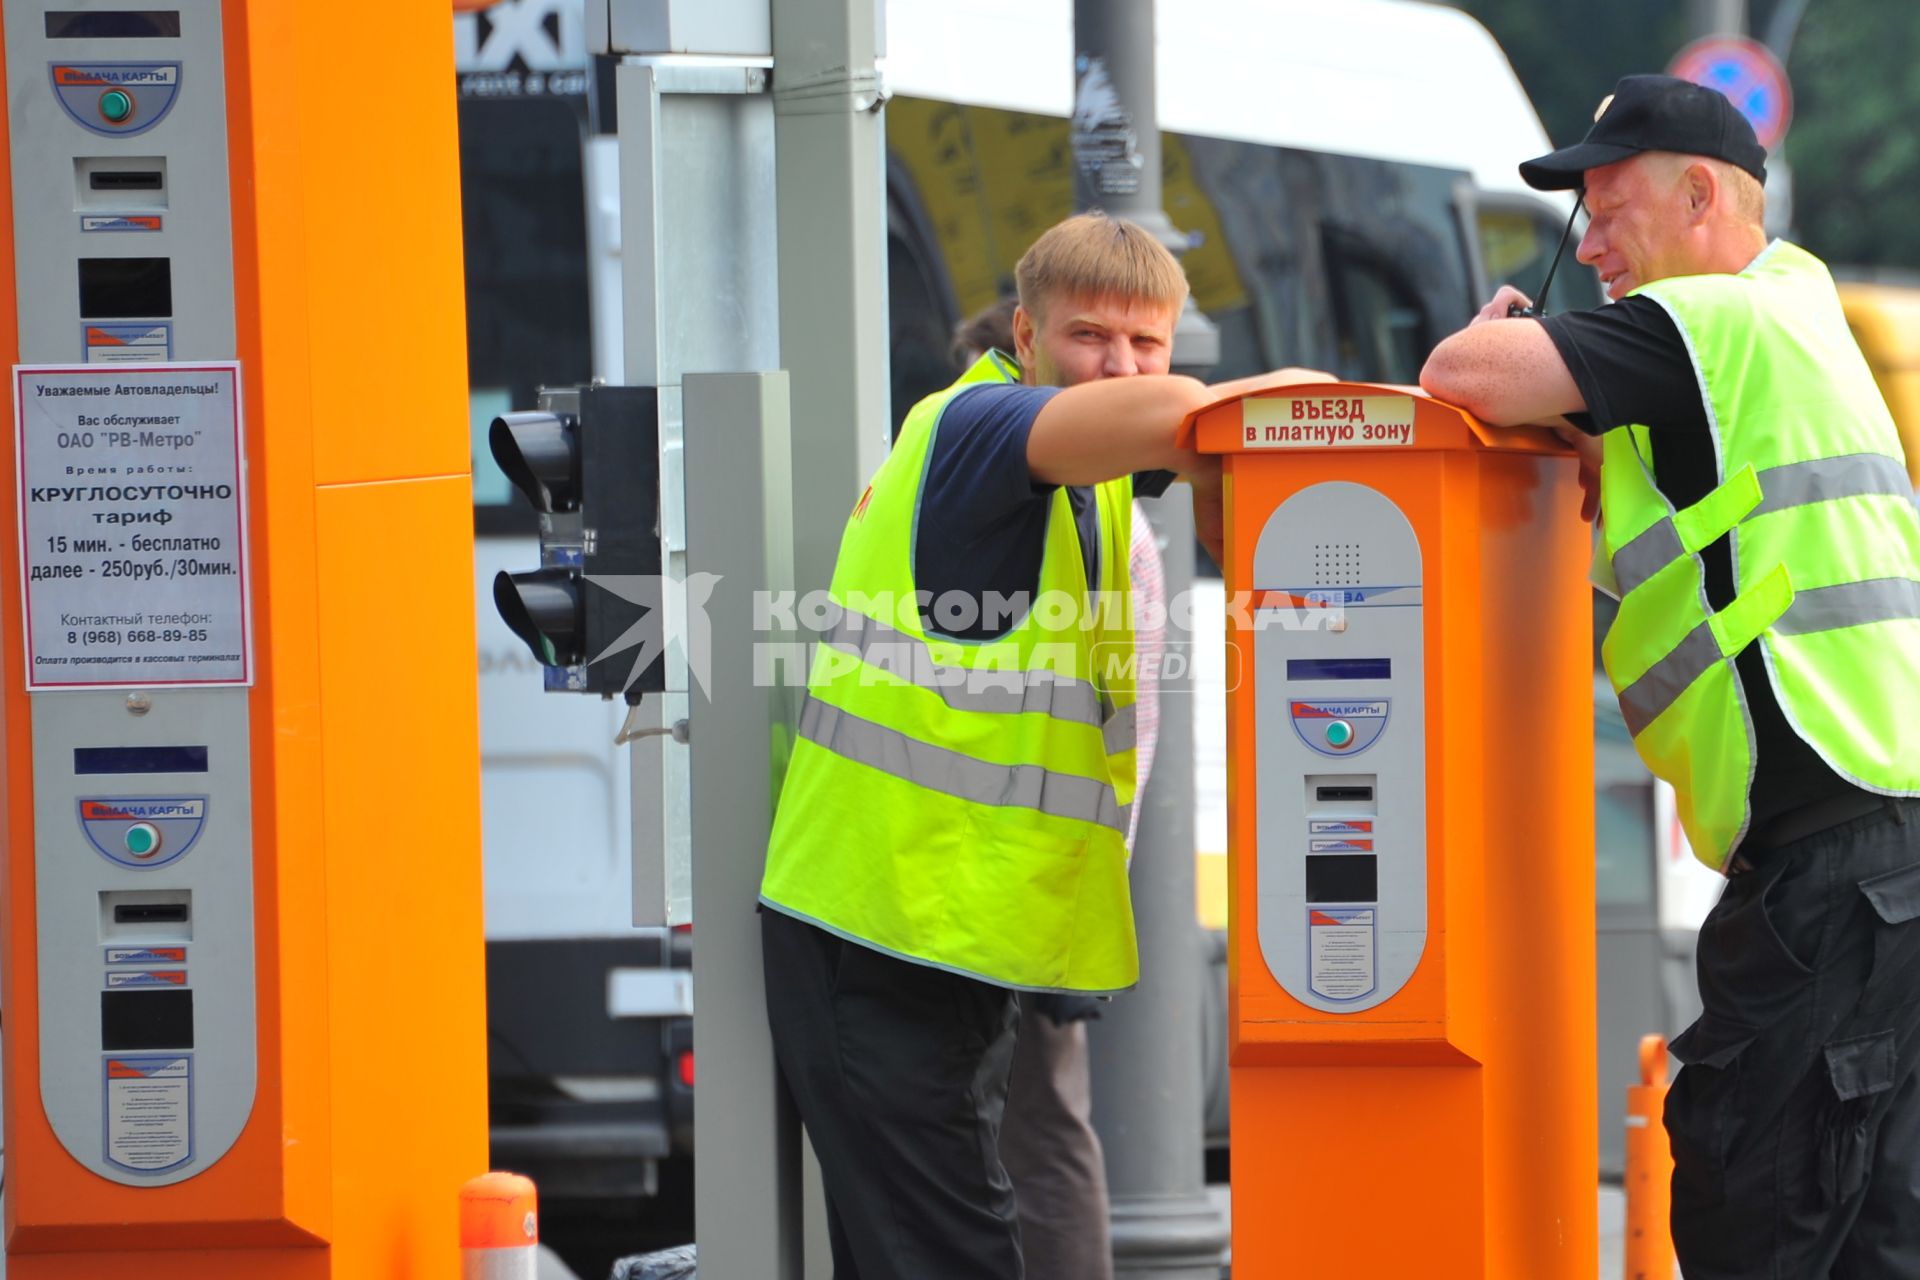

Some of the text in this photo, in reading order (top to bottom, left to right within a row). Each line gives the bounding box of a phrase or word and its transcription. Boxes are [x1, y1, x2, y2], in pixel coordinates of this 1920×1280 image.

[64, 71, 167, 81] ВЫДАЧА КАРТЫ
[36, 382, 219, 397] Уважаемые Автовладельцы!
[1291, 399, 1365, 423] ВЪЕЗД
[77, 414, 181, 428] Вас обслуживает
[57, 430, 202, 450] ОАО "РВ-Метро"
[1245, 424, 1411, 445] в платную зону
[65, 465, 193, 476] Время работы:
[30, 484, 232, 503] КРУГЛОСУТОЧНО
[92, 509, 173, 526] тариф
[47, 536, 67, 553] 15
[73, 539, 112, 553] мин.
[131, 534, 221, 551] бесплатно
[31, 564, 83, 581] далее
[101, 558, 237, 580] 250руб./30мин.
[1309, 592, 1365, 602] ВЪЕЗД
[60, 612, 212, 627] Контактный телефон:
[67, 629, 208, 646] 8 (968) 668-89-85
[35, 655, 68, 665] Оплата
[70, 656, 133, 665] производится
[143, 655, 184, 664] кассовых
[187, 653, 241, 664] терминалах
[1344, 706, 1380, 714] КАРТЫ
[92, 805, 194, 816] ВЫДАЧА КАРТЫ
